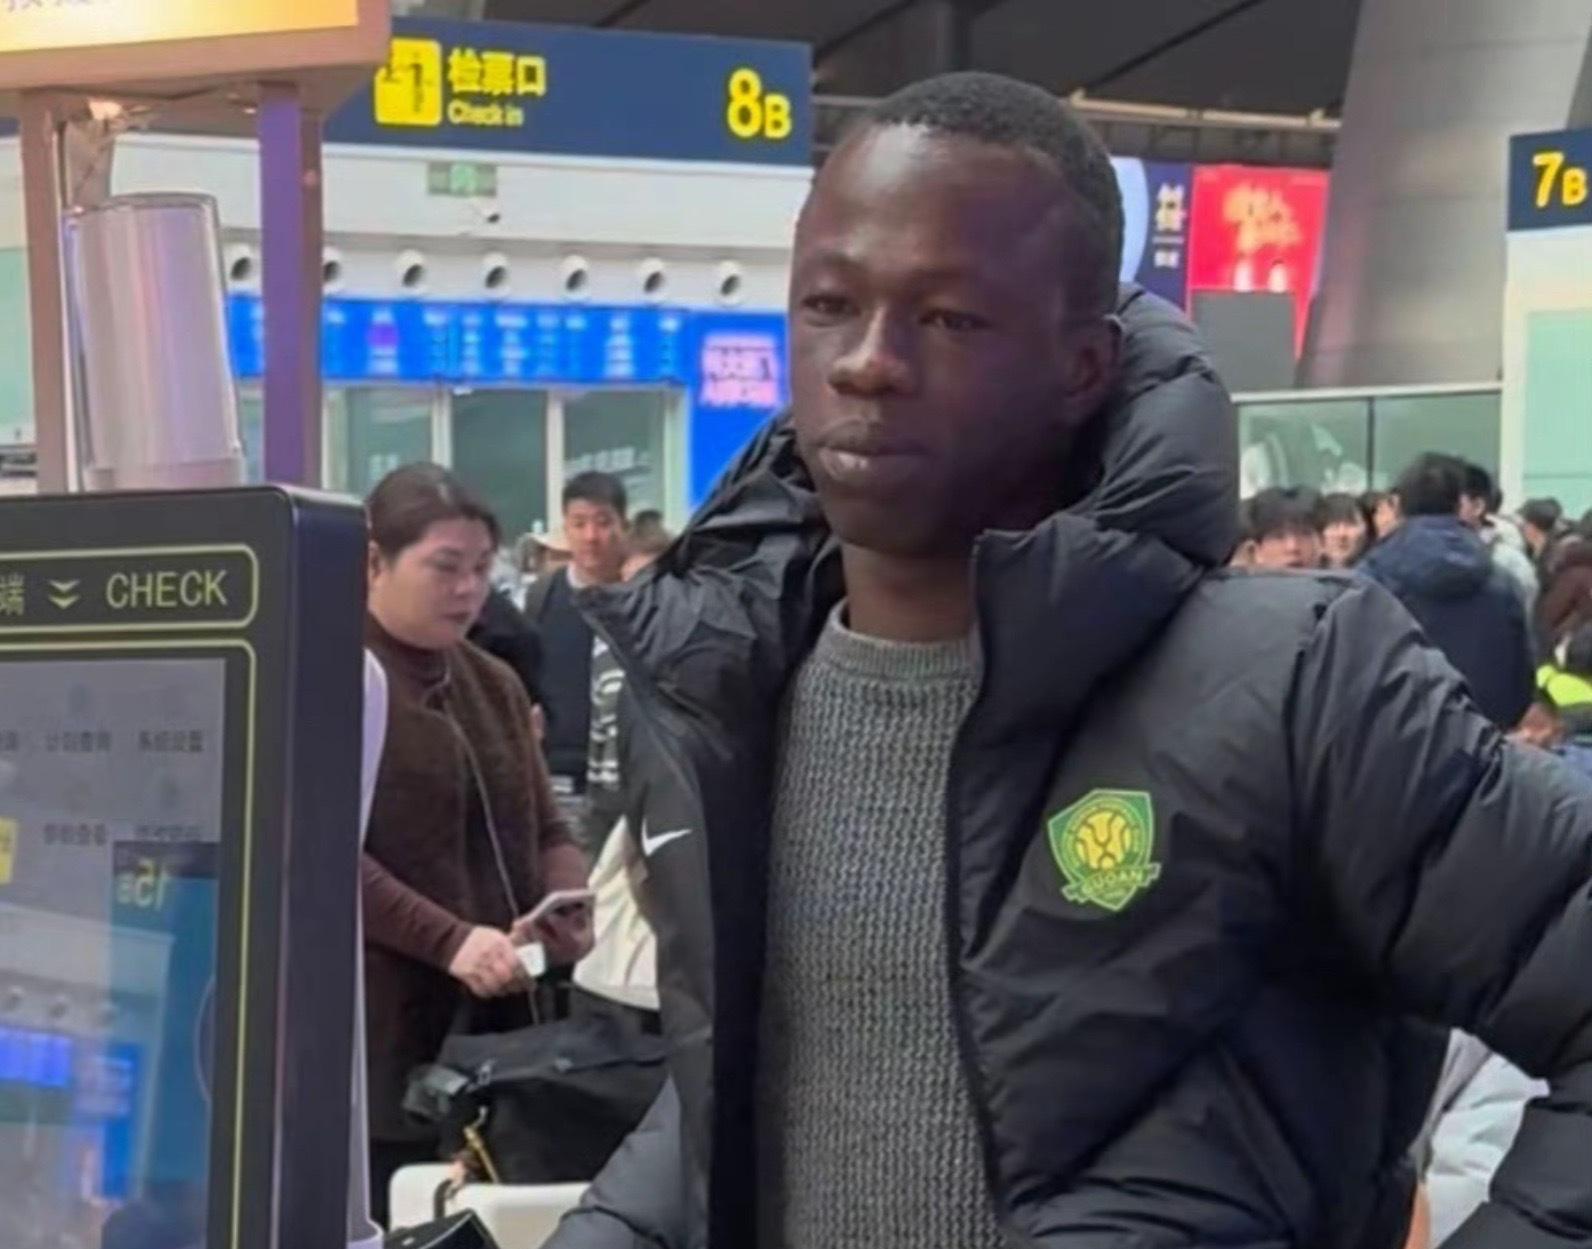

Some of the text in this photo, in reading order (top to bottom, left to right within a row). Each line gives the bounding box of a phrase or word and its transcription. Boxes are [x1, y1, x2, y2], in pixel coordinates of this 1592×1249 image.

[727, 68, 792, 139] 8B
[1532, 151, 1588, 208] 7B
[106, 569, 228, 610] CHECK
